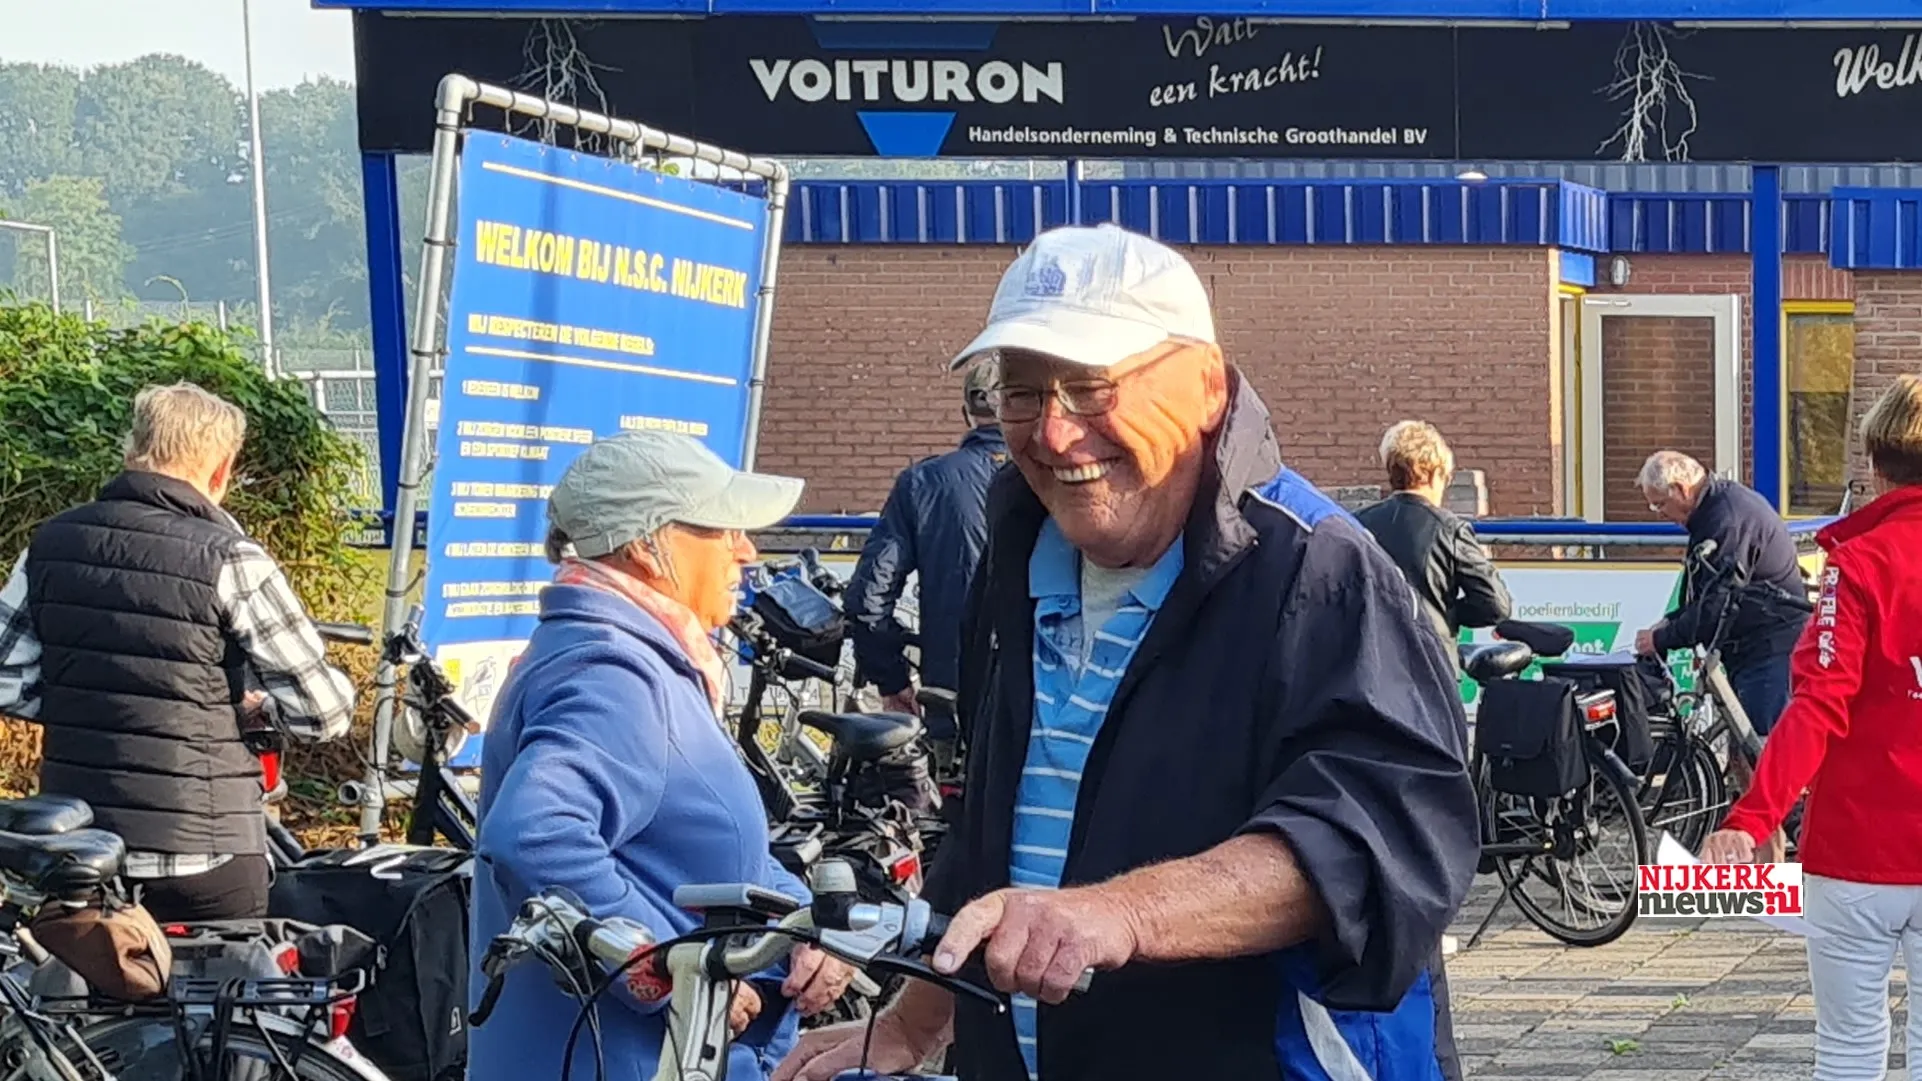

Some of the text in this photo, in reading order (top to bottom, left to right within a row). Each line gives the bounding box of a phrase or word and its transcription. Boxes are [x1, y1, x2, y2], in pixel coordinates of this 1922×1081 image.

[749, 59, 1063, 104] VOITURON
[1149, 46, 1323, 107] een kracht!
[968, 126, 1428, 147] Handelsonderneming & Technische Groothandel BV
[475, 219, 749, 309] WELKOM BIJ N.S.C. NIJKERK
